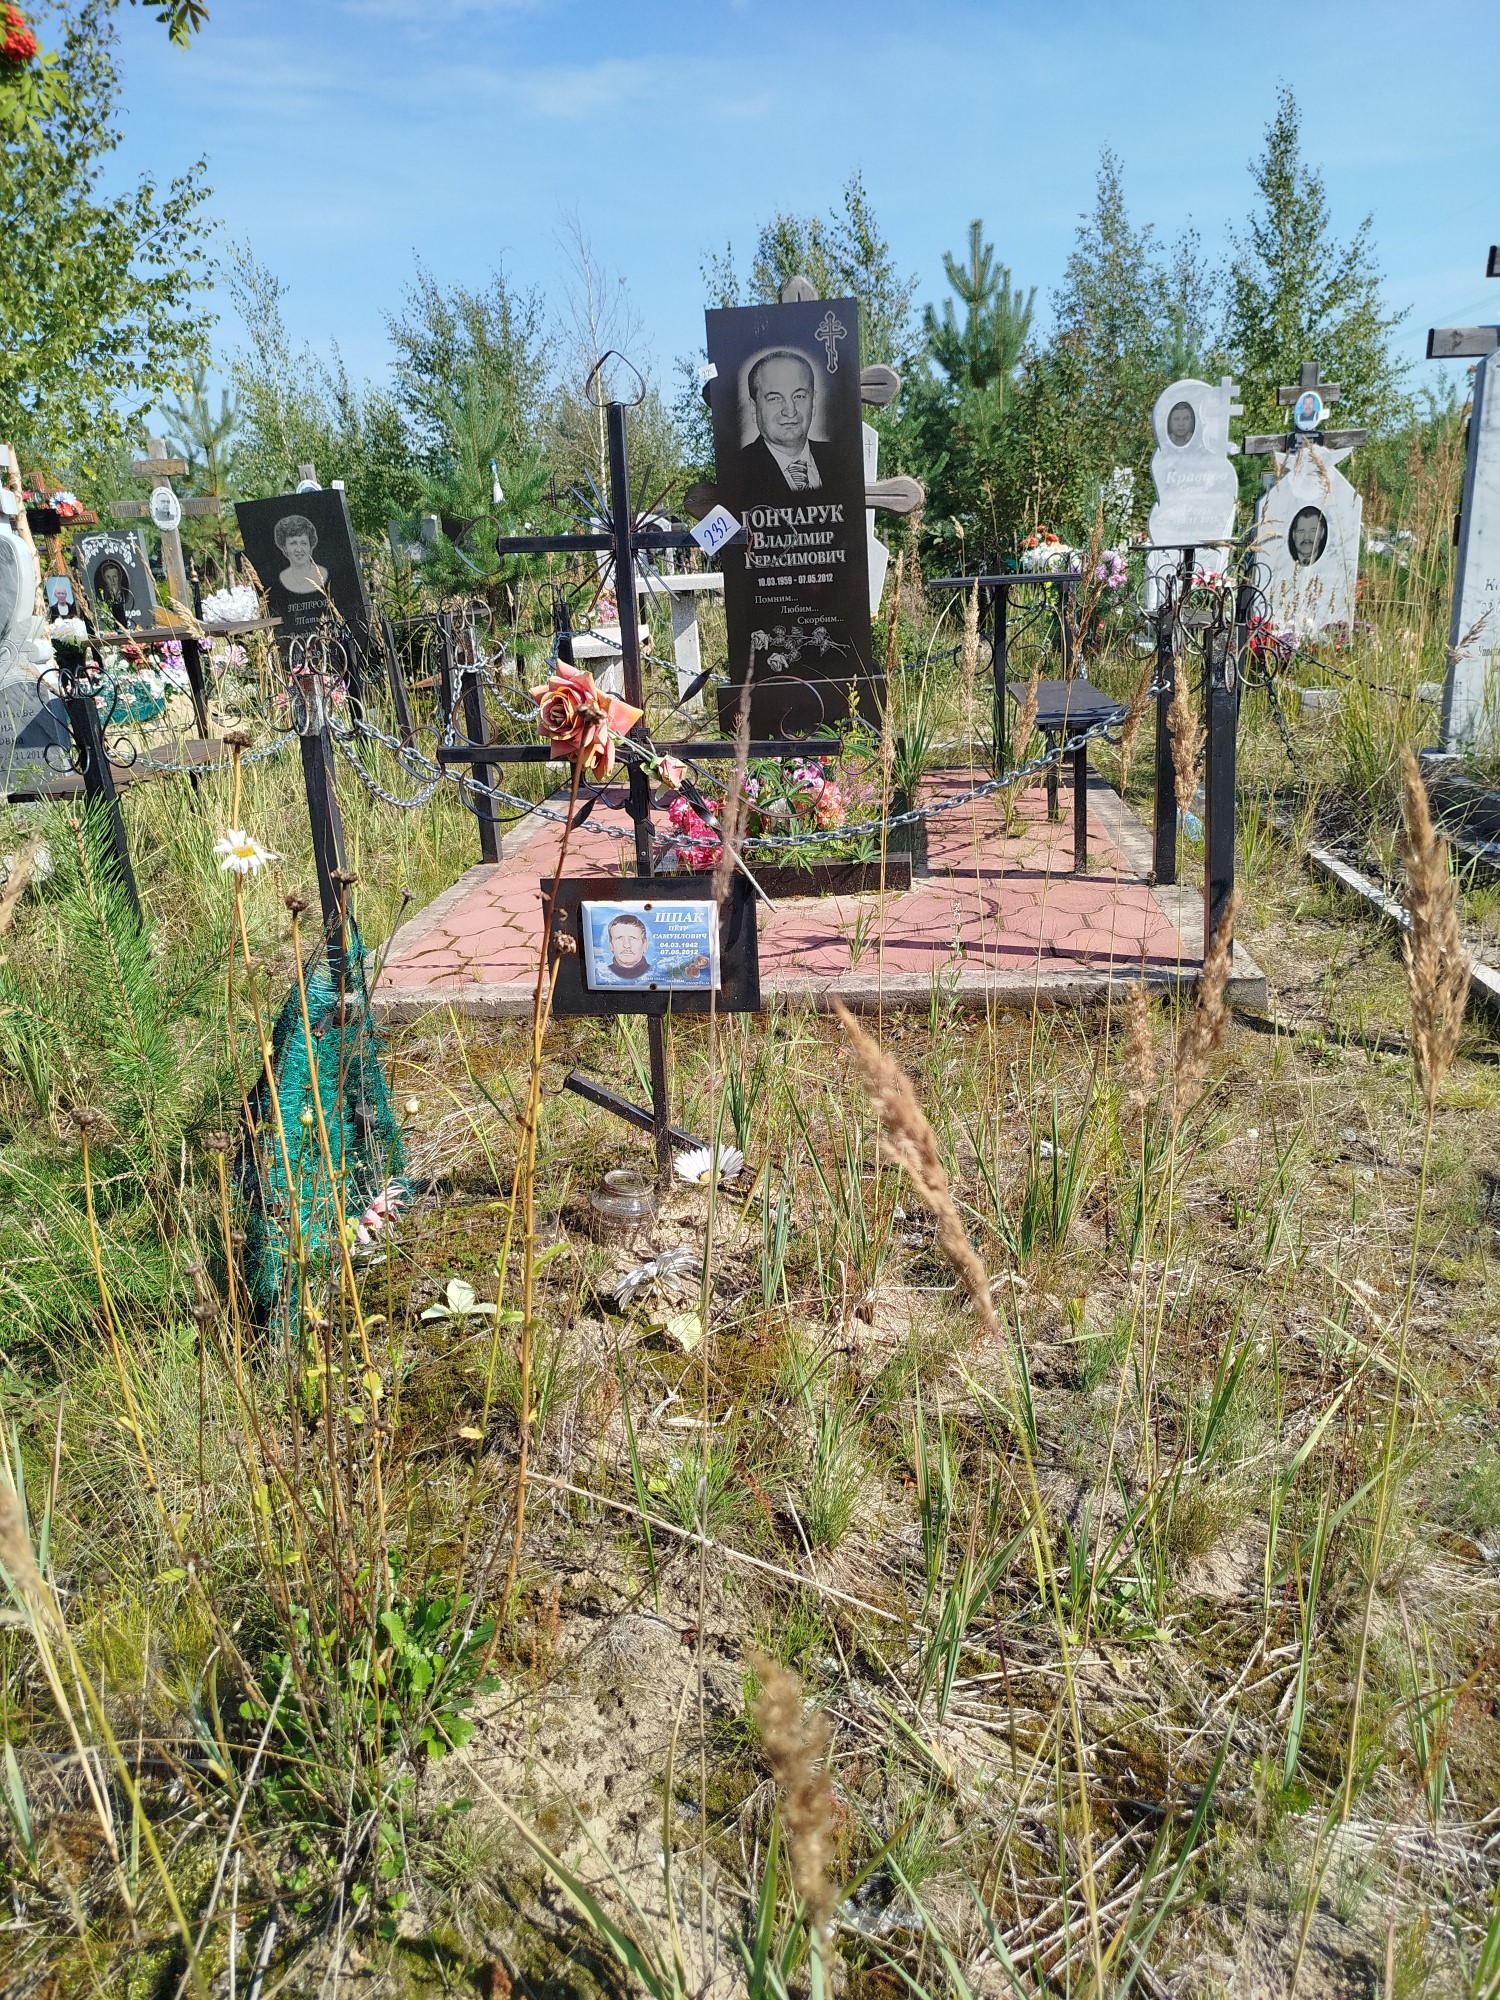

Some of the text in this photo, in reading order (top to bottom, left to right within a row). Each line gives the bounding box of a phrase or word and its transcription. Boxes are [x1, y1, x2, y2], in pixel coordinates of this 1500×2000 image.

[741, 504, 845, 528] ГОНЧАРУК
[703, 516, 732, 547] 232
[758, 576, 792, 586] 10.03.1959
[798, 573, 834, 585] 07.05.2012
[754, 595, 799, 604] Помним...
[780, 605, 819, 615] Любим...
[797, 615, 845, 626] Скорбим...
[654, 912, 704, 922] ШПАК
